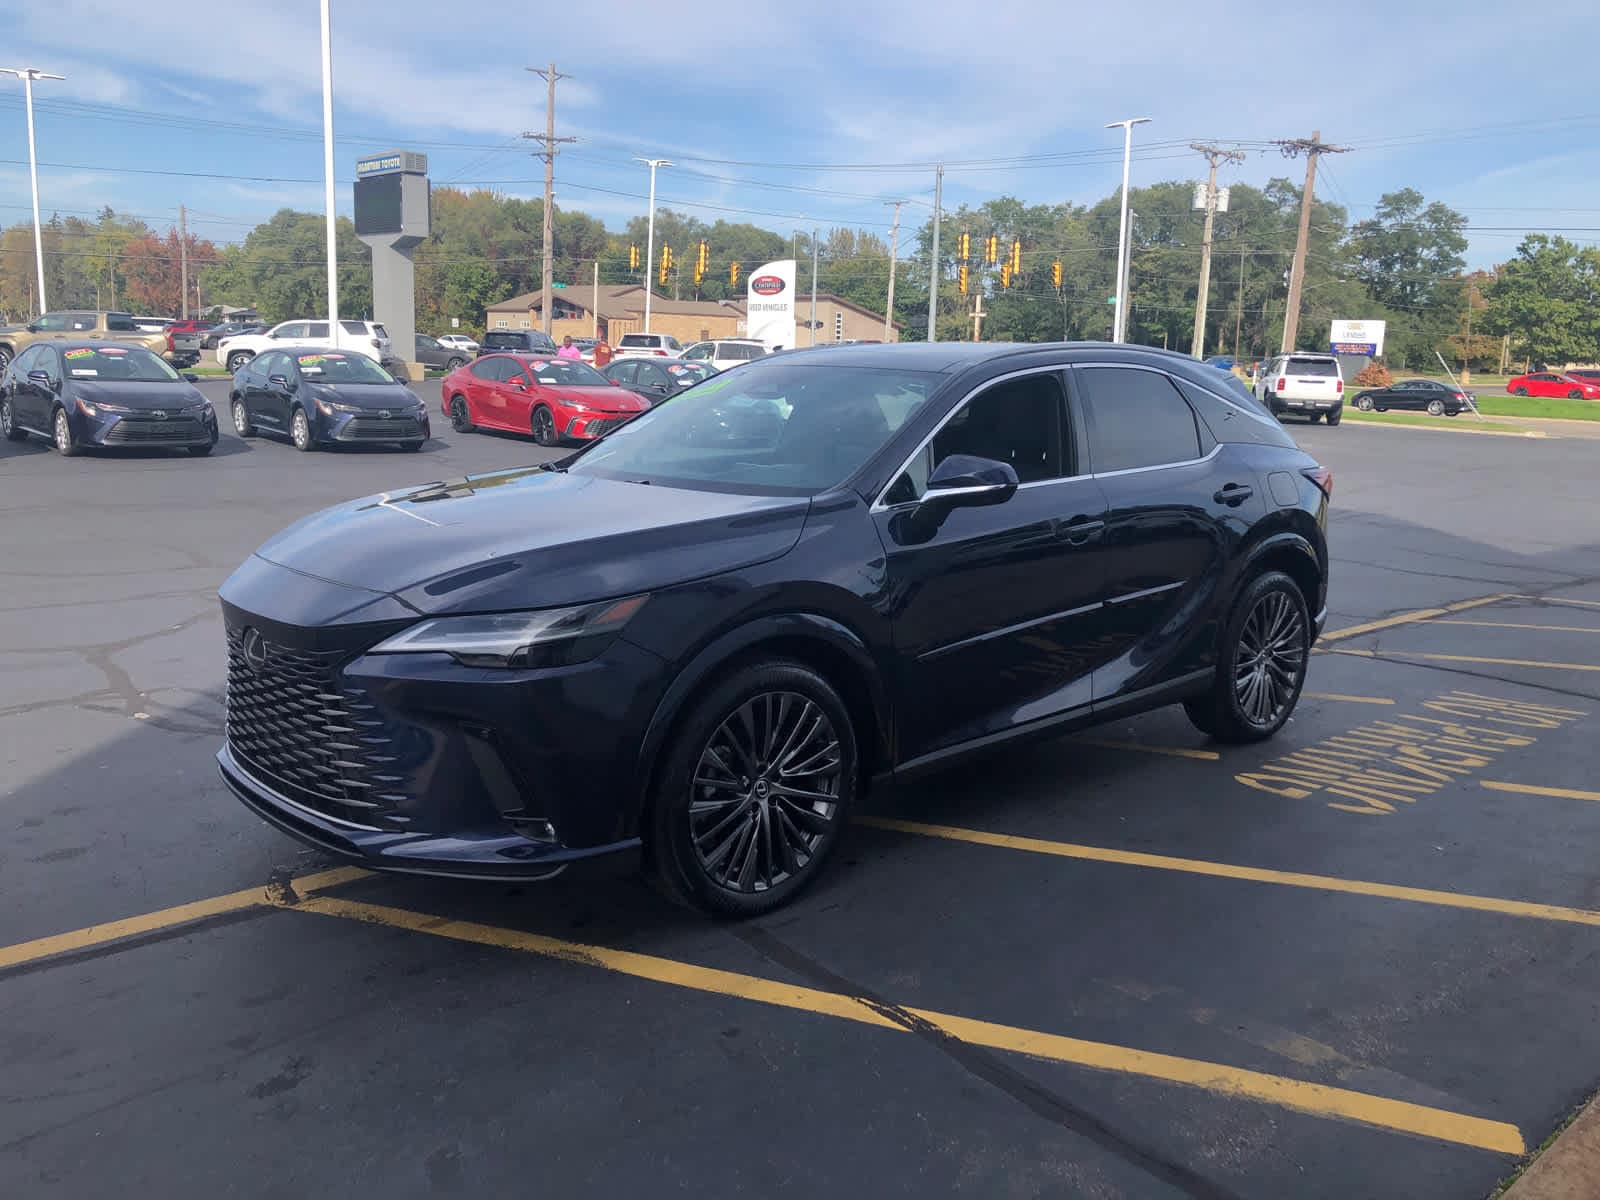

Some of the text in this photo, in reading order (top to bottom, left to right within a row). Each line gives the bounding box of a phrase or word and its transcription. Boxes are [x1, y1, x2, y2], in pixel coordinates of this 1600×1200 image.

[762, 303, 788, 312] VEHICLES
[1234, 690, 1591, 815] NO PARKING
